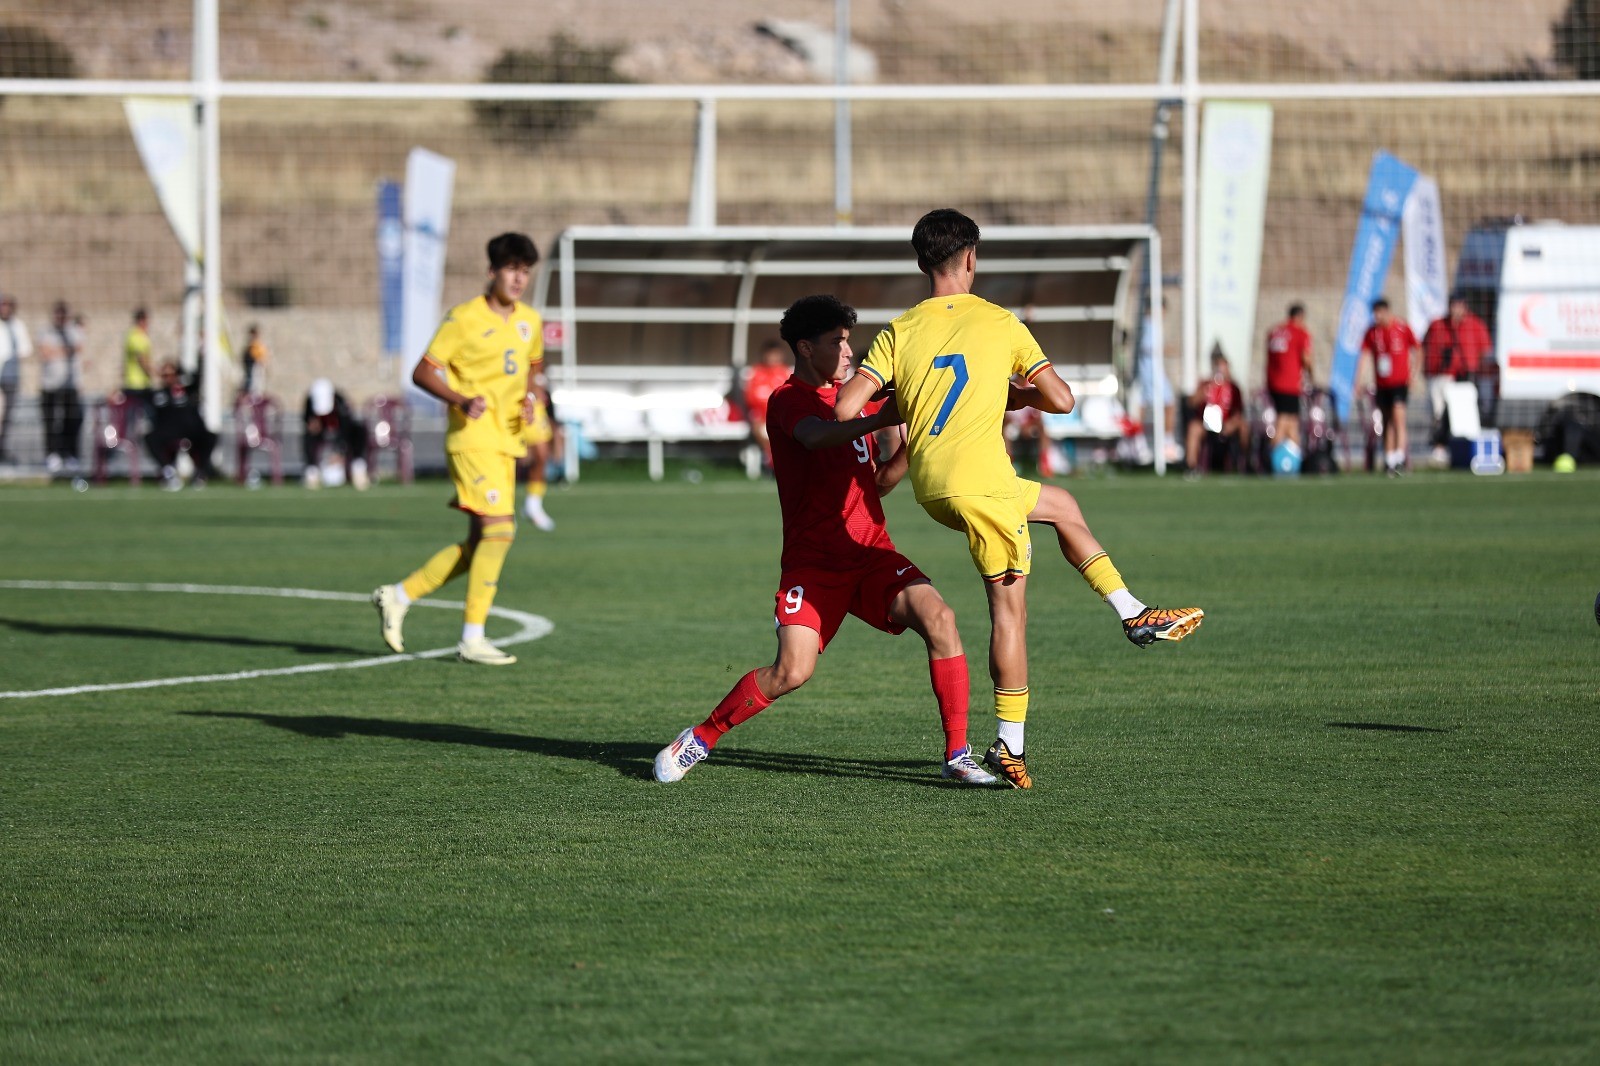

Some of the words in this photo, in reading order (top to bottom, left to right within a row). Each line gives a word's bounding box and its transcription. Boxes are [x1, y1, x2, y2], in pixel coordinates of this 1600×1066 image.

[504, 349, 518, 375] 6
[929, 353, 970, 436] 7
[785, 585, 804, 615] 9
